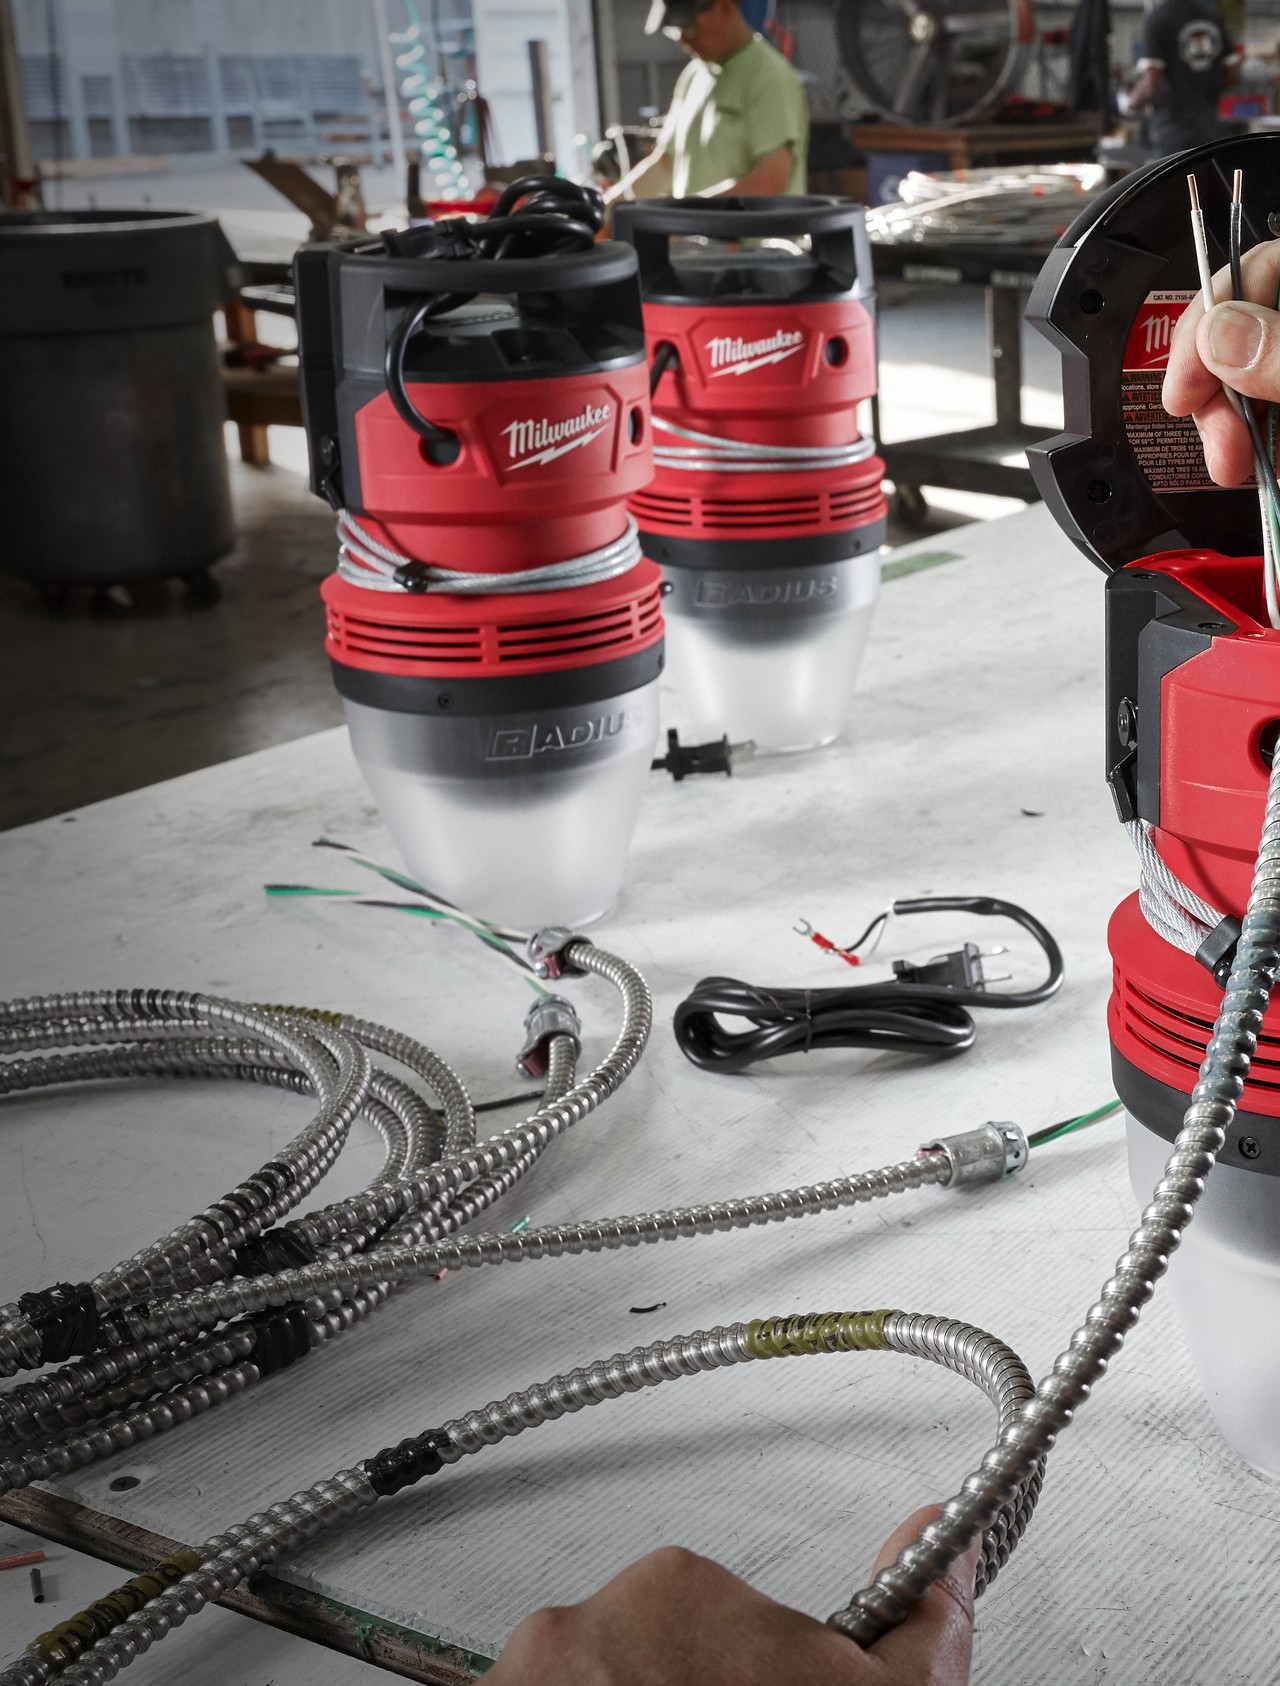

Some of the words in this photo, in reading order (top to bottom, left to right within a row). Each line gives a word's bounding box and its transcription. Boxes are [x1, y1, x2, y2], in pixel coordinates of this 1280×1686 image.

[705, 330, 803, 368] Milwaukee
[1132, 392, 1163, 402] AVERTISS
[501, 404, 610, 458] Milwaukee
[486, 712, 626, 761] RADIU
